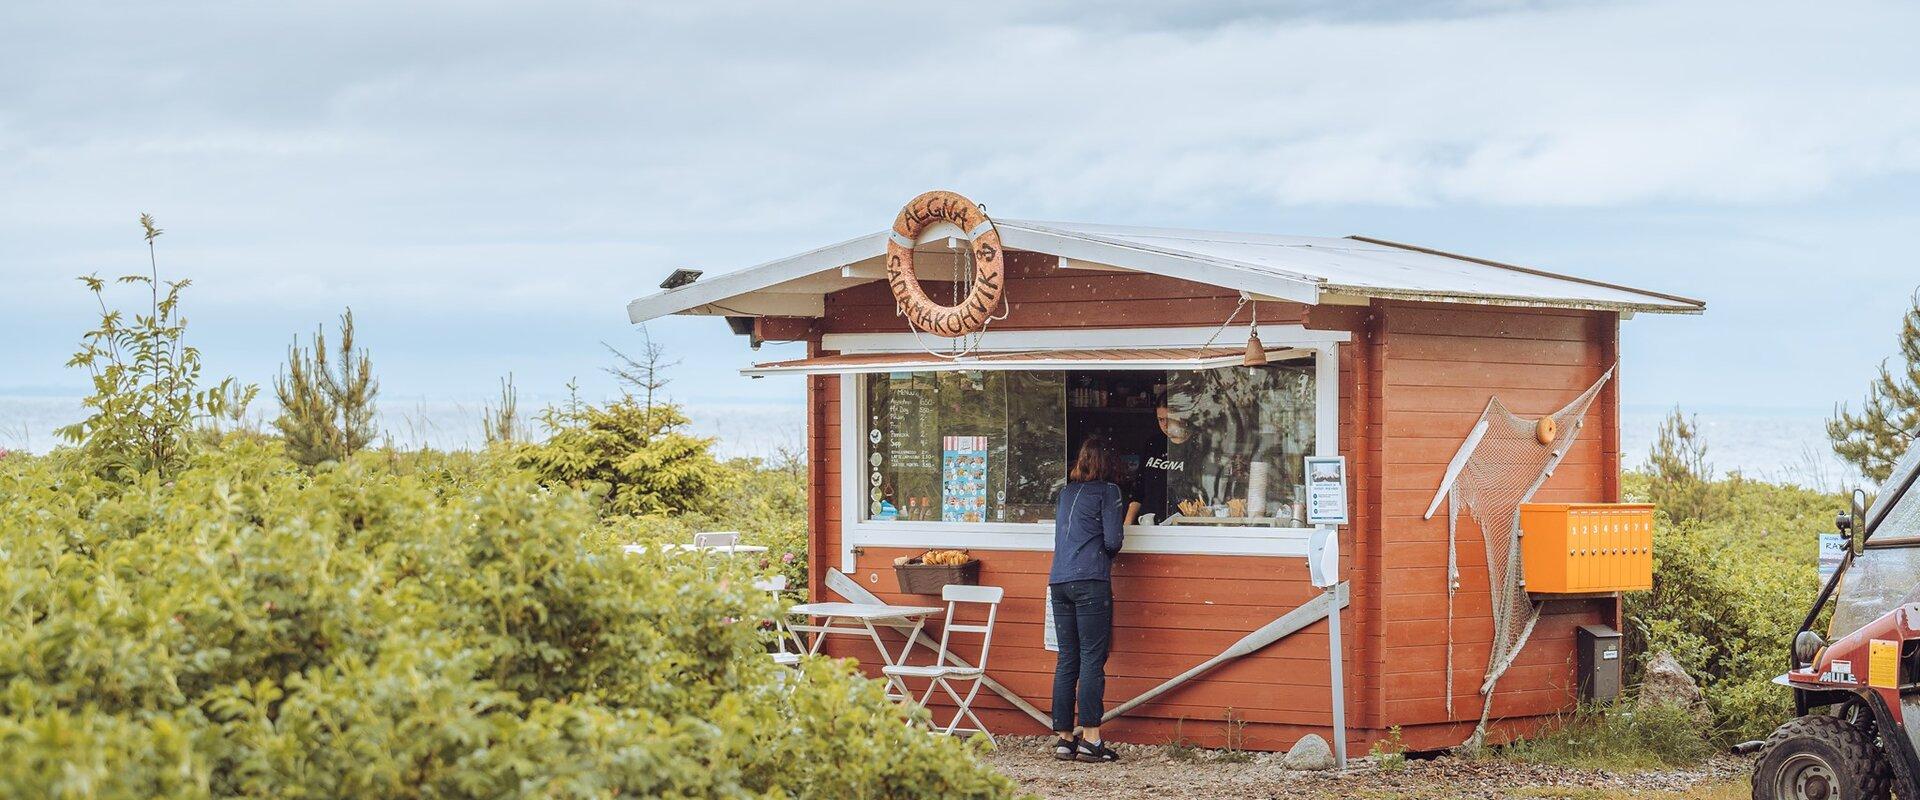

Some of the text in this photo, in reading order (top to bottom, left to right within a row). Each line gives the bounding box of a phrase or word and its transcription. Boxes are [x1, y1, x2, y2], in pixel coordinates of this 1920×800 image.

[904, 196, 968, 234] AEGNA
[888, 254, 998, 334] SADAMAKOHVIK
[1145, 457, 1184, 471] AEGNA
[1572, 526, 1577, 535] 1
[1582, 526, 1587, 535] 2
[1593, 525, 1598, 534] 3
[1603, 524, 1608, 533] 4
[1614, 524, 1619, 533] 5
[1624, 523, 1629, 531] 6
[1634, 523, 1639, 531] 7
[1818, 671, 1859, 685] MULE
